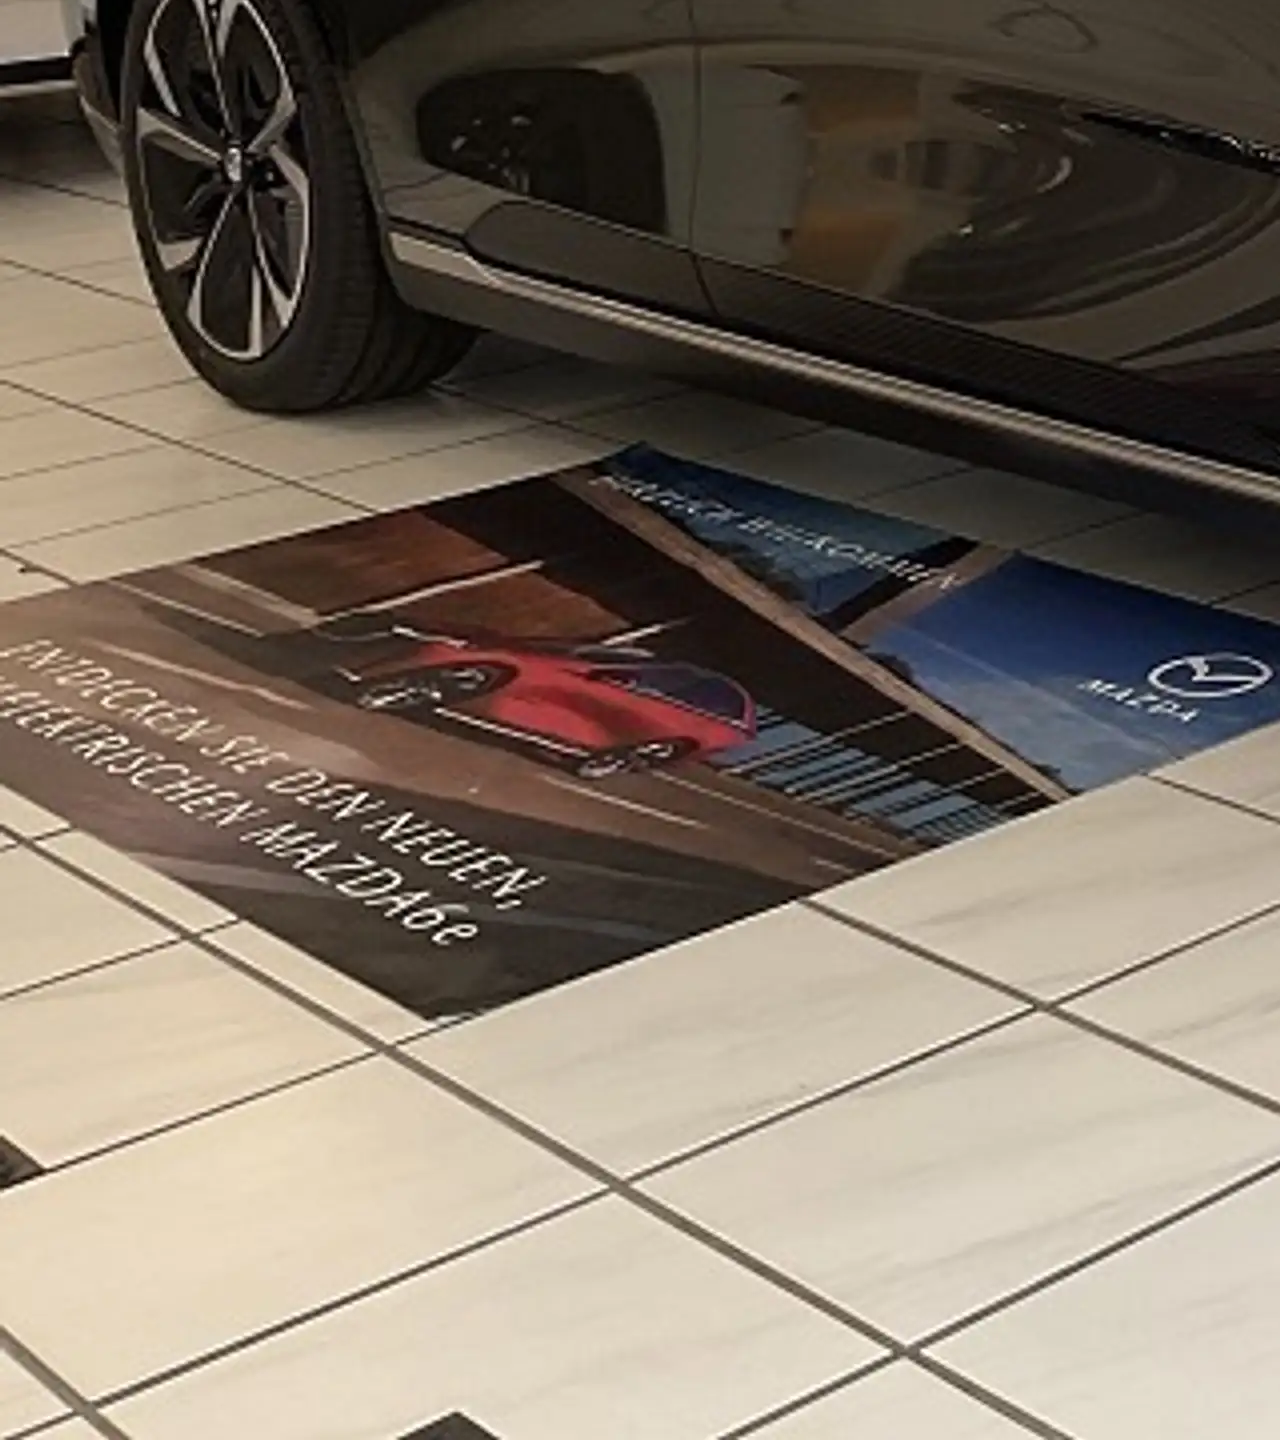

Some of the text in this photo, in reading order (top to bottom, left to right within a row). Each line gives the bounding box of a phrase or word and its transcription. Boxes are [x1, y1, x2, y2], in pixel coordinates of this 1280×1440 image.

[1076, 679, 1198, 722] MAZDA
[0, 639, 547, 910] ENTDECKEN SIE DEN NEUEN,
[238, 822, 479, 946] MAZDA6e
